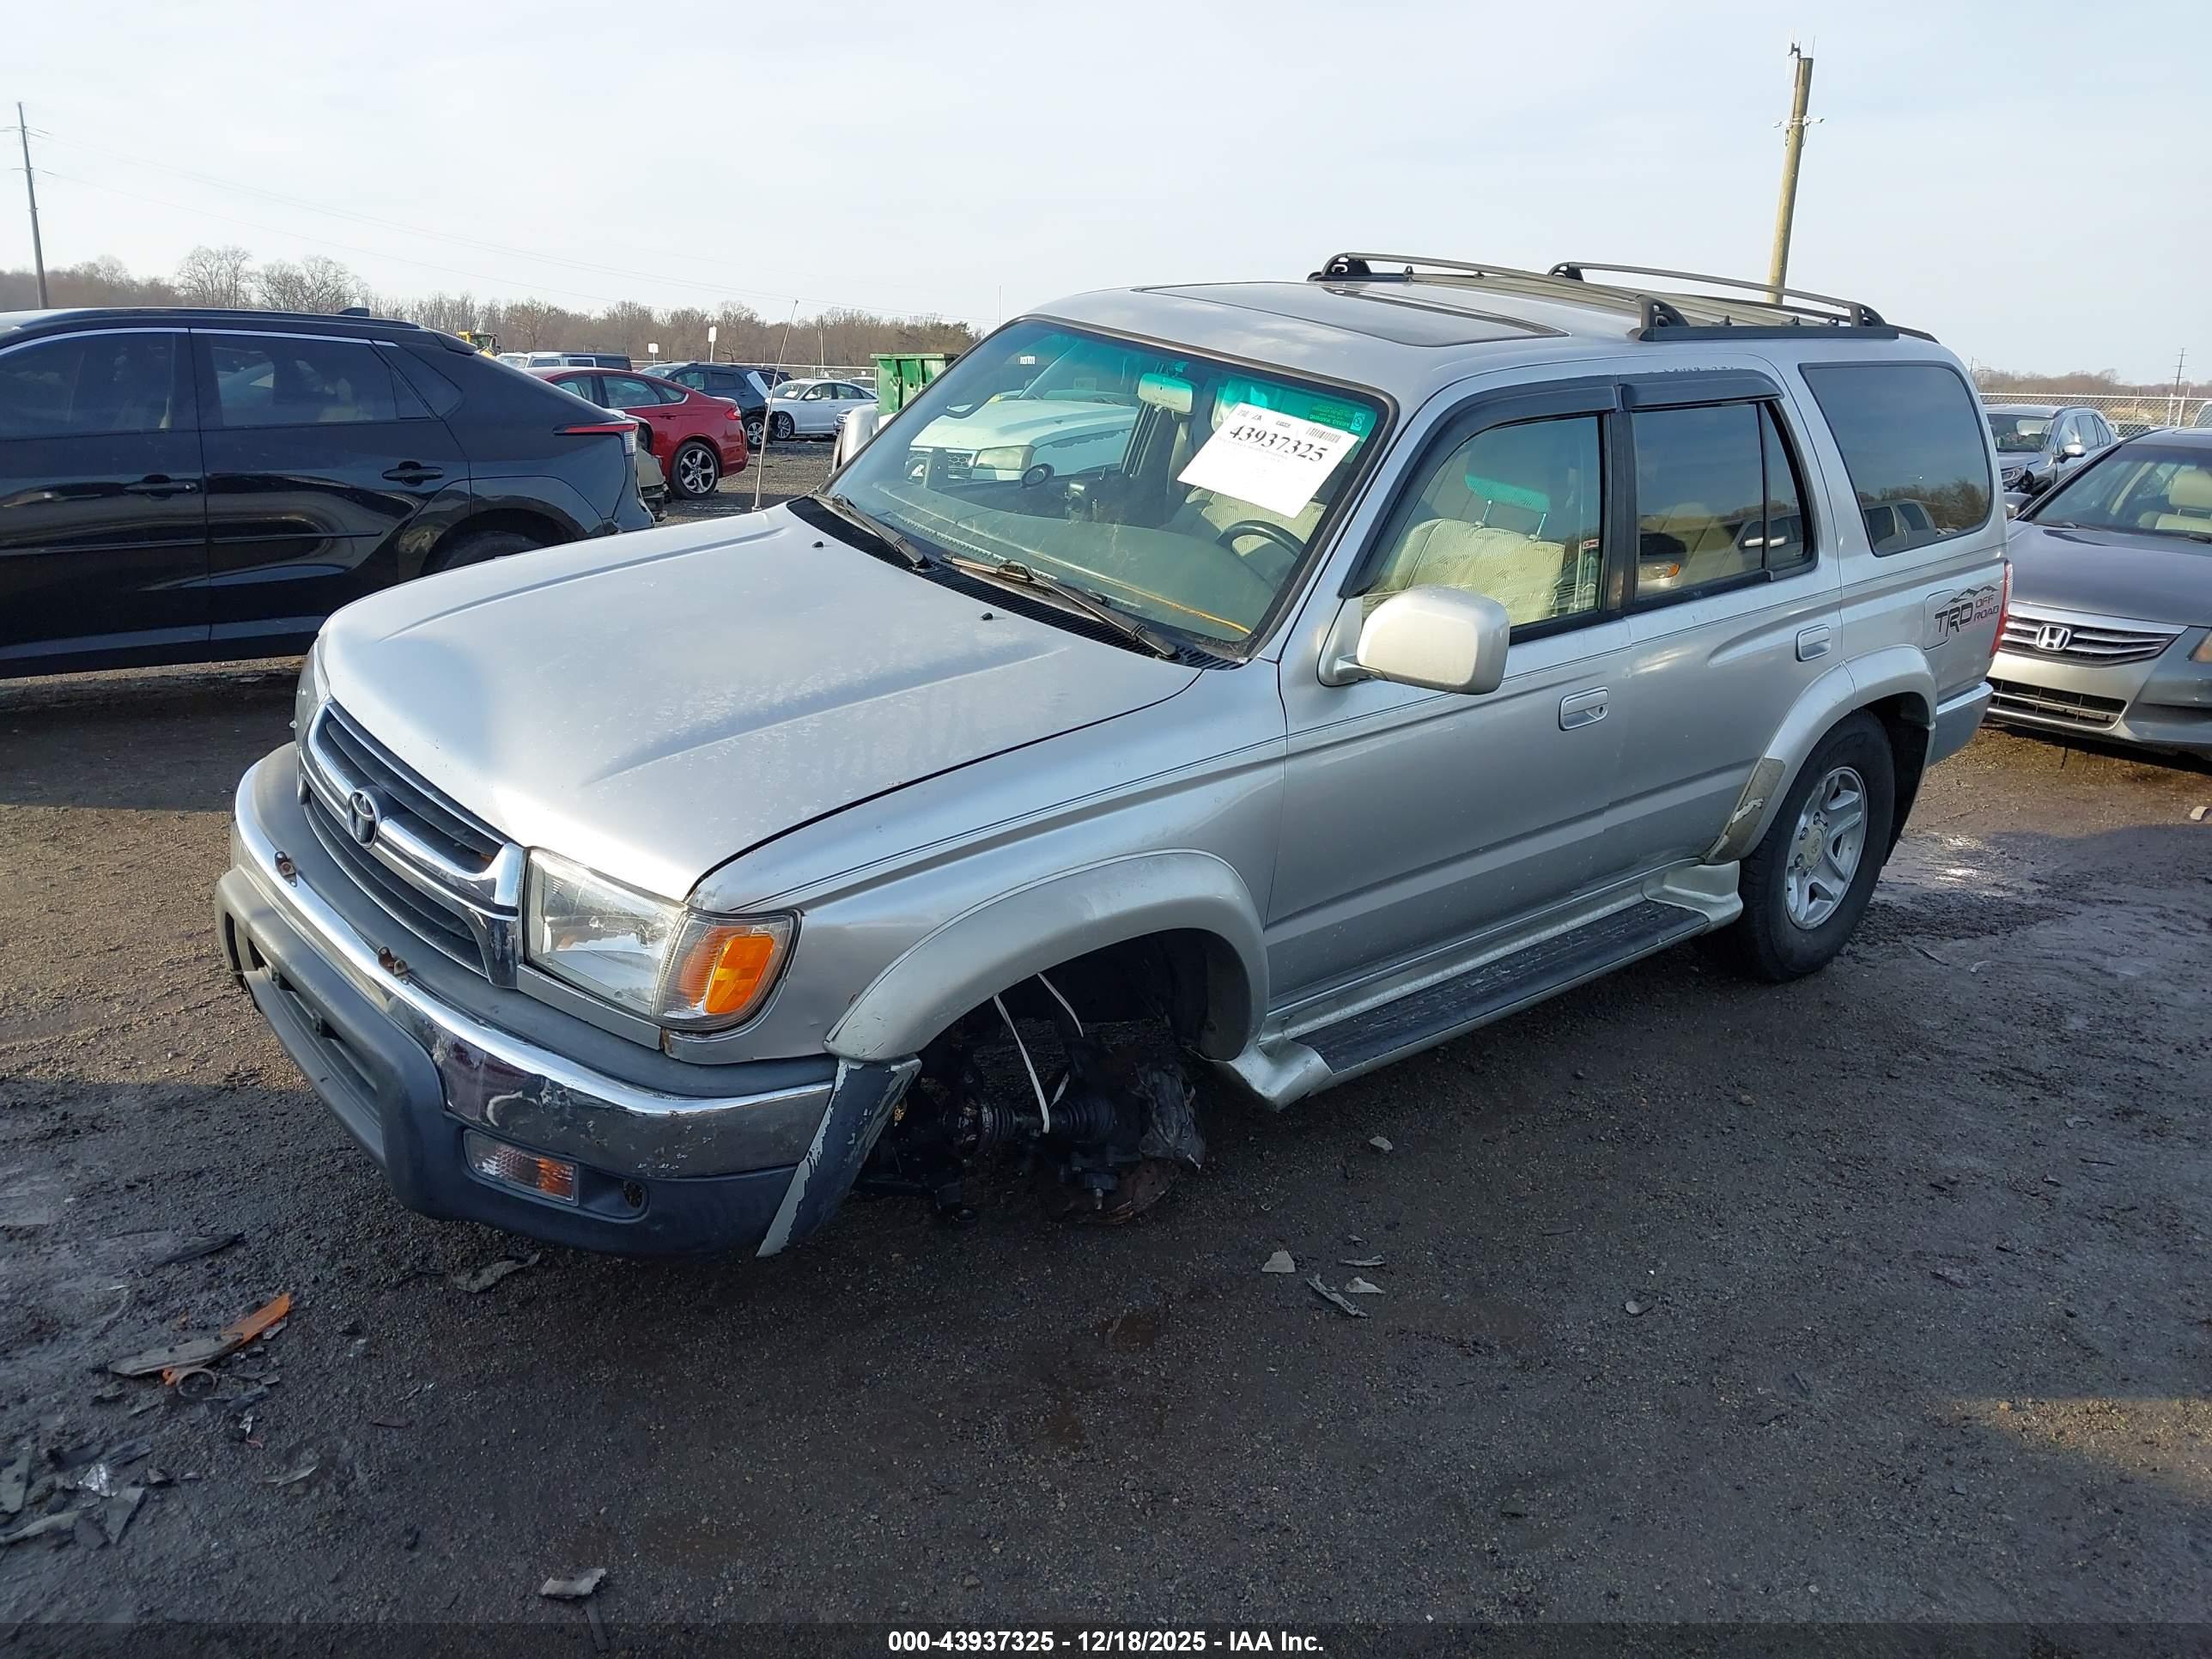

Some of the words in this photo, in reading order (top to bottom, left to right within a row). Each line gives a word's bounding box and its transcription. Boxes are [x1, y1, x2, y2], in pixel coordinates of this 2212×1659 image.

[1230, 425, 1328, 461] 43937325
[1935, 602, 1973, 637] TRD
[1976, 594, 1994, 608] OFF
[1974, 605, 1999, 622] ROAD
